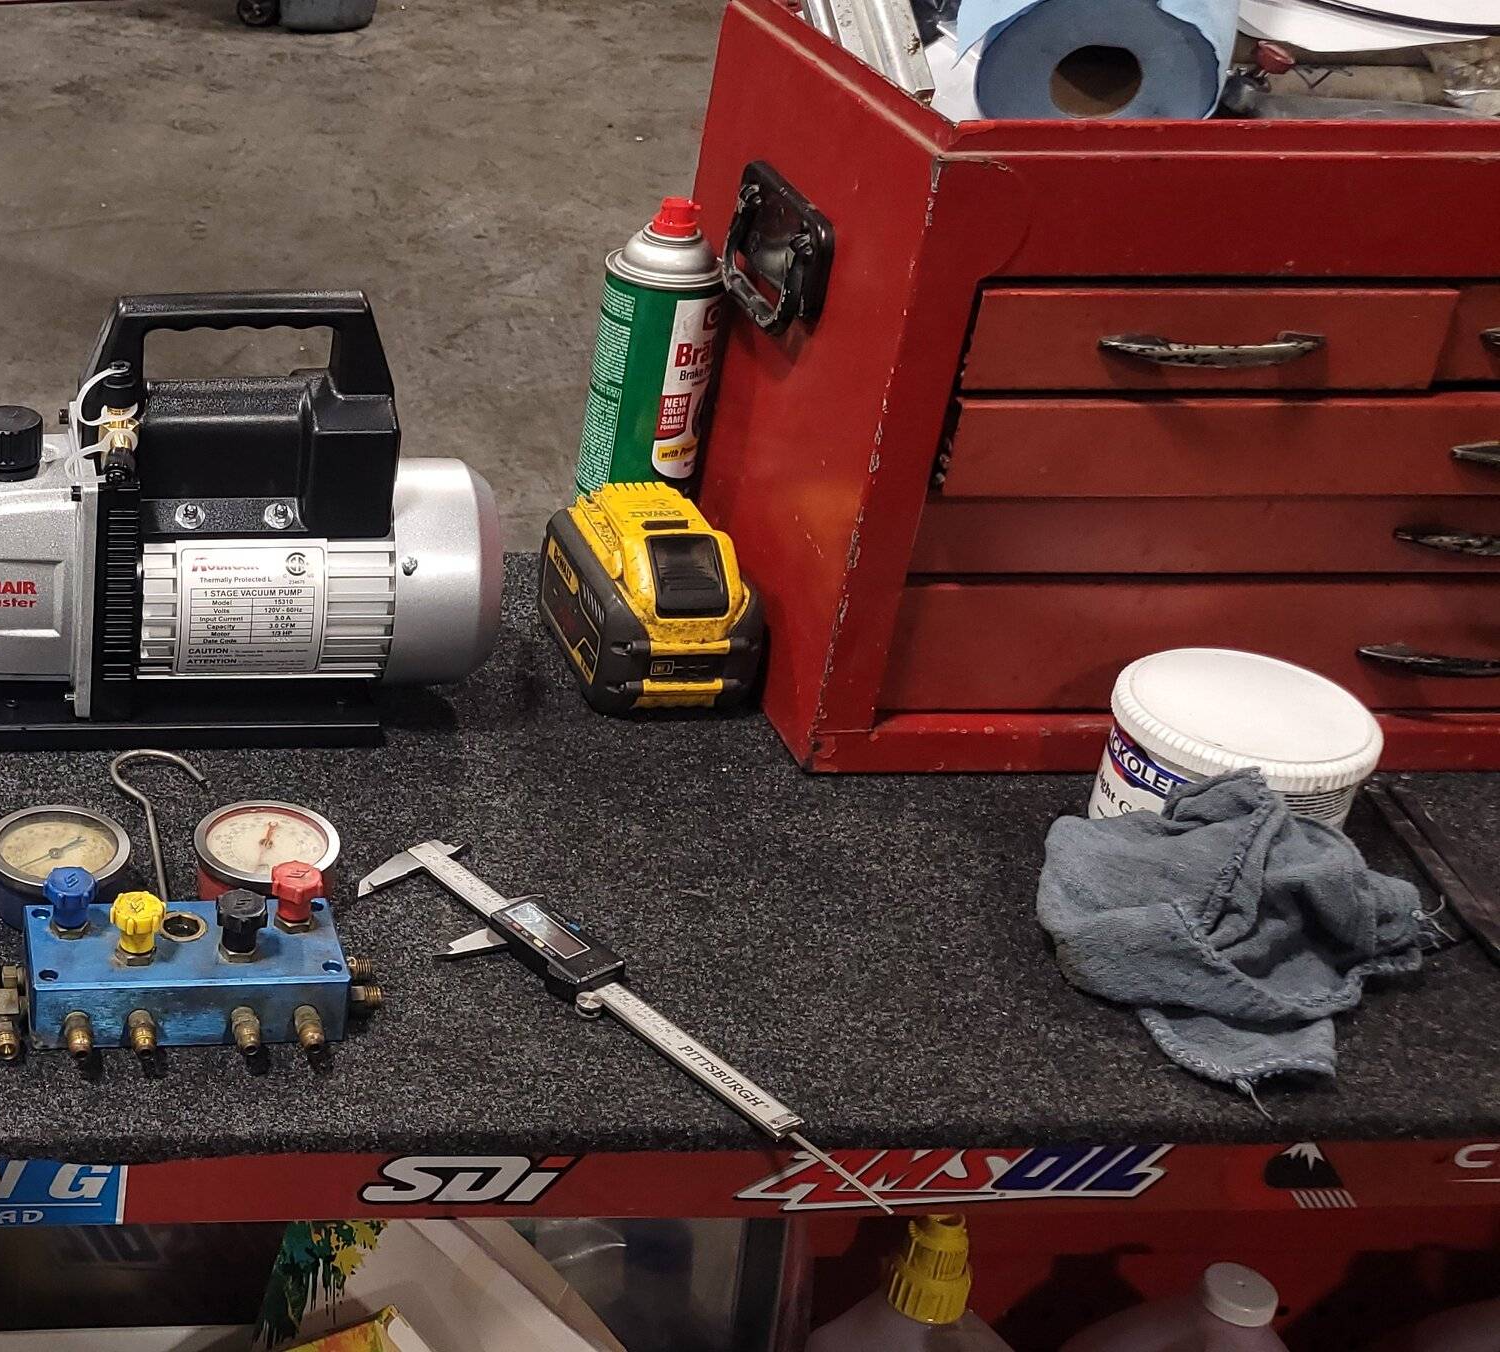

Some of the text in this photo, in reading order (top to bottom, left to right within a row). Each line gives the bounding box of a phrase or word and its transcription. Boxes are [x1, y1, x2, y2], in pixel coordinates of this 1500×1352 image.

[664, 397, 688, 408] NEW
[662, 407, 687, 416] COLOR
[661, 415, 685, 425] SAME
[661, 449, 679, 459] with
[241, 589, 276, 597] VACUUM
[678, 1044, 766, 1108] PITTSBURGH
[735, 1143, 1174, 1212] AMSOIL
